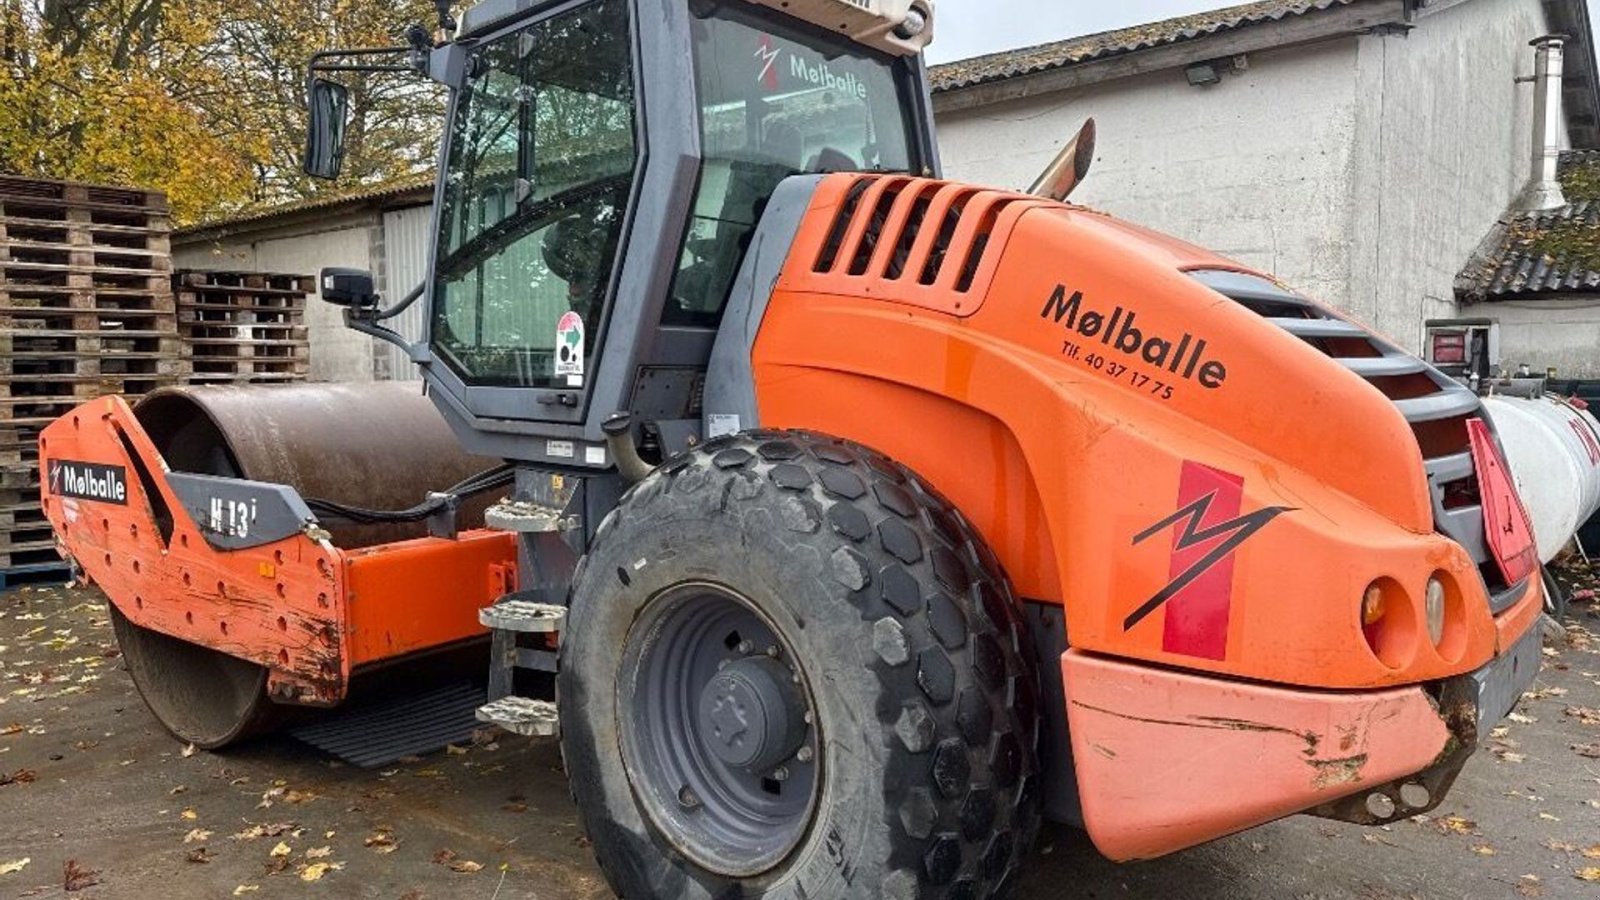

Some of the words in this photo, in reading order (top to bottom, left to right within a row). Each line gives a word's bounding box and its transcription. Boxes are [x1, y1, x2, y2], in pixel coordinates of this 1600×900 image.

[790, 54, 866, 98] Mølballe
[1041, 284, 1226, 389] Mølballe
[1062, 340, 1080, 360] Tlf.
[1084, 353, 1104, 369] 40
[1106, 362, 1128, 378] 37
[1131, 371, 1150, 388] 17
[1151, 381, 1174, 400] 75
[64, 465, 126, 501] Mølballe
[210, 497, 222, 532] H
